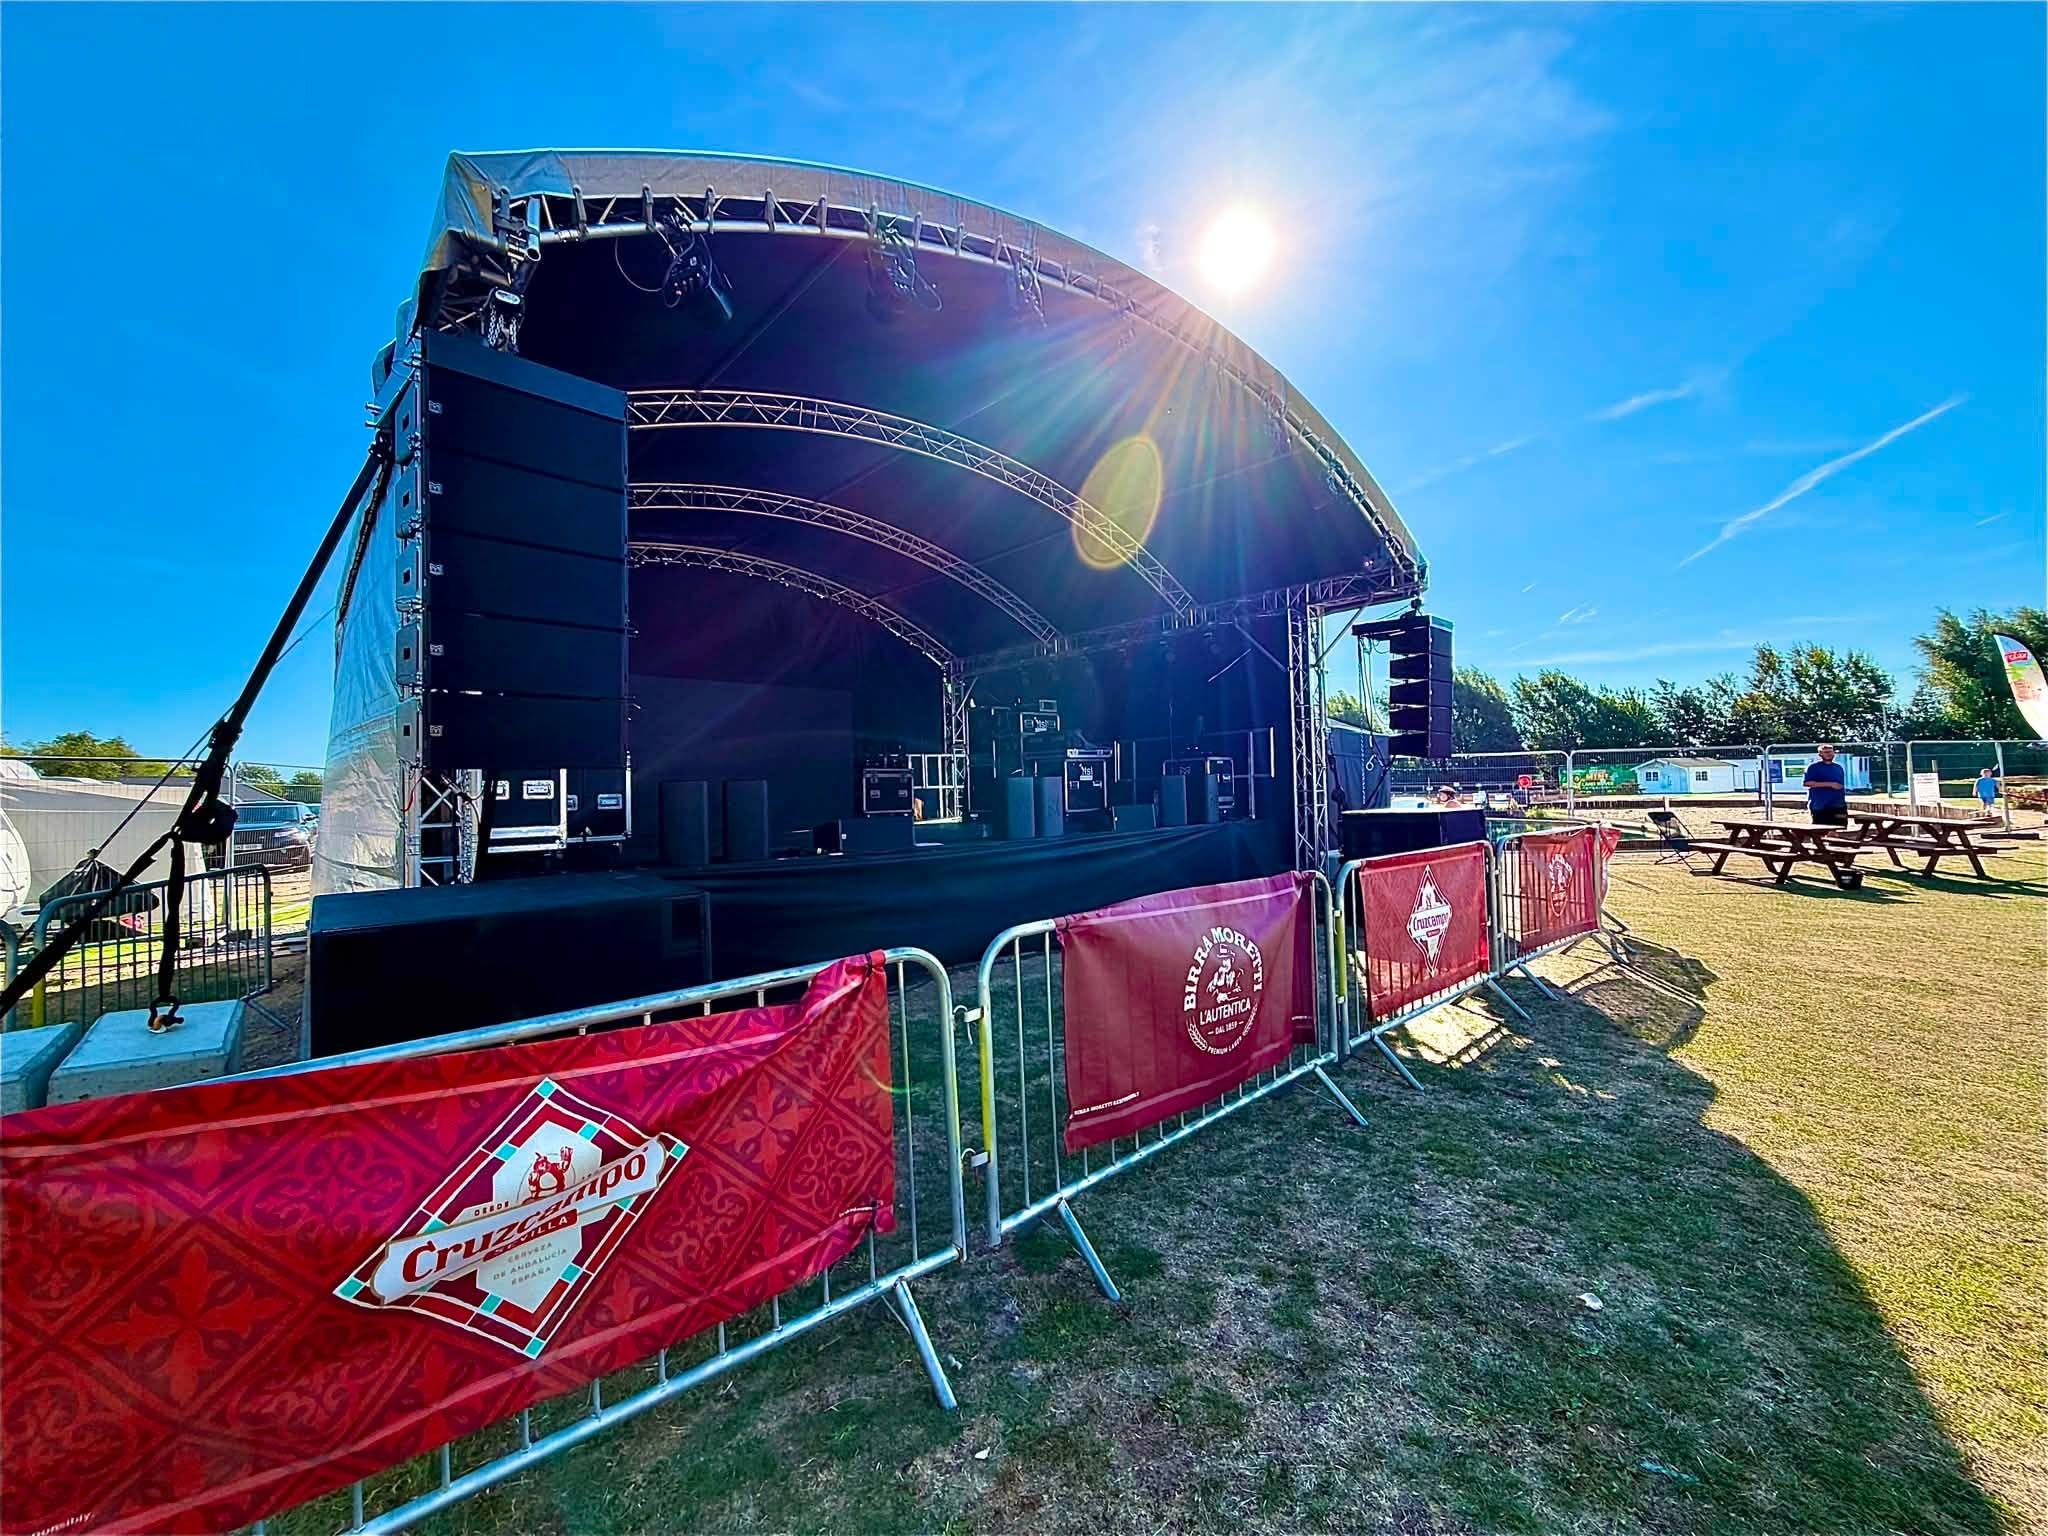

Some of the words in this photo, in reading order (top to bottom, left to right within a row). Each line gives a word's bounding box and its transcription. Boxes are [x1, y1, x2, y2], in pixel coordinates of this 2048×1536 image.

[1183, 936, 1213, 1011] BIRRA
[1210, 926, 1264, 992] MORETTI
[1199, 997, 1251, 1026] L'AUTENTICA
[1215, 1025, 1226, 1035] DAL
[1207, 1046, 1228, 1055] PREMIUM
[402, 1153, 646, 1283] Cruzcampo
[507, 1241, 553, 1264] CERVEZA
[492, 1270, 507, 1281] DE
